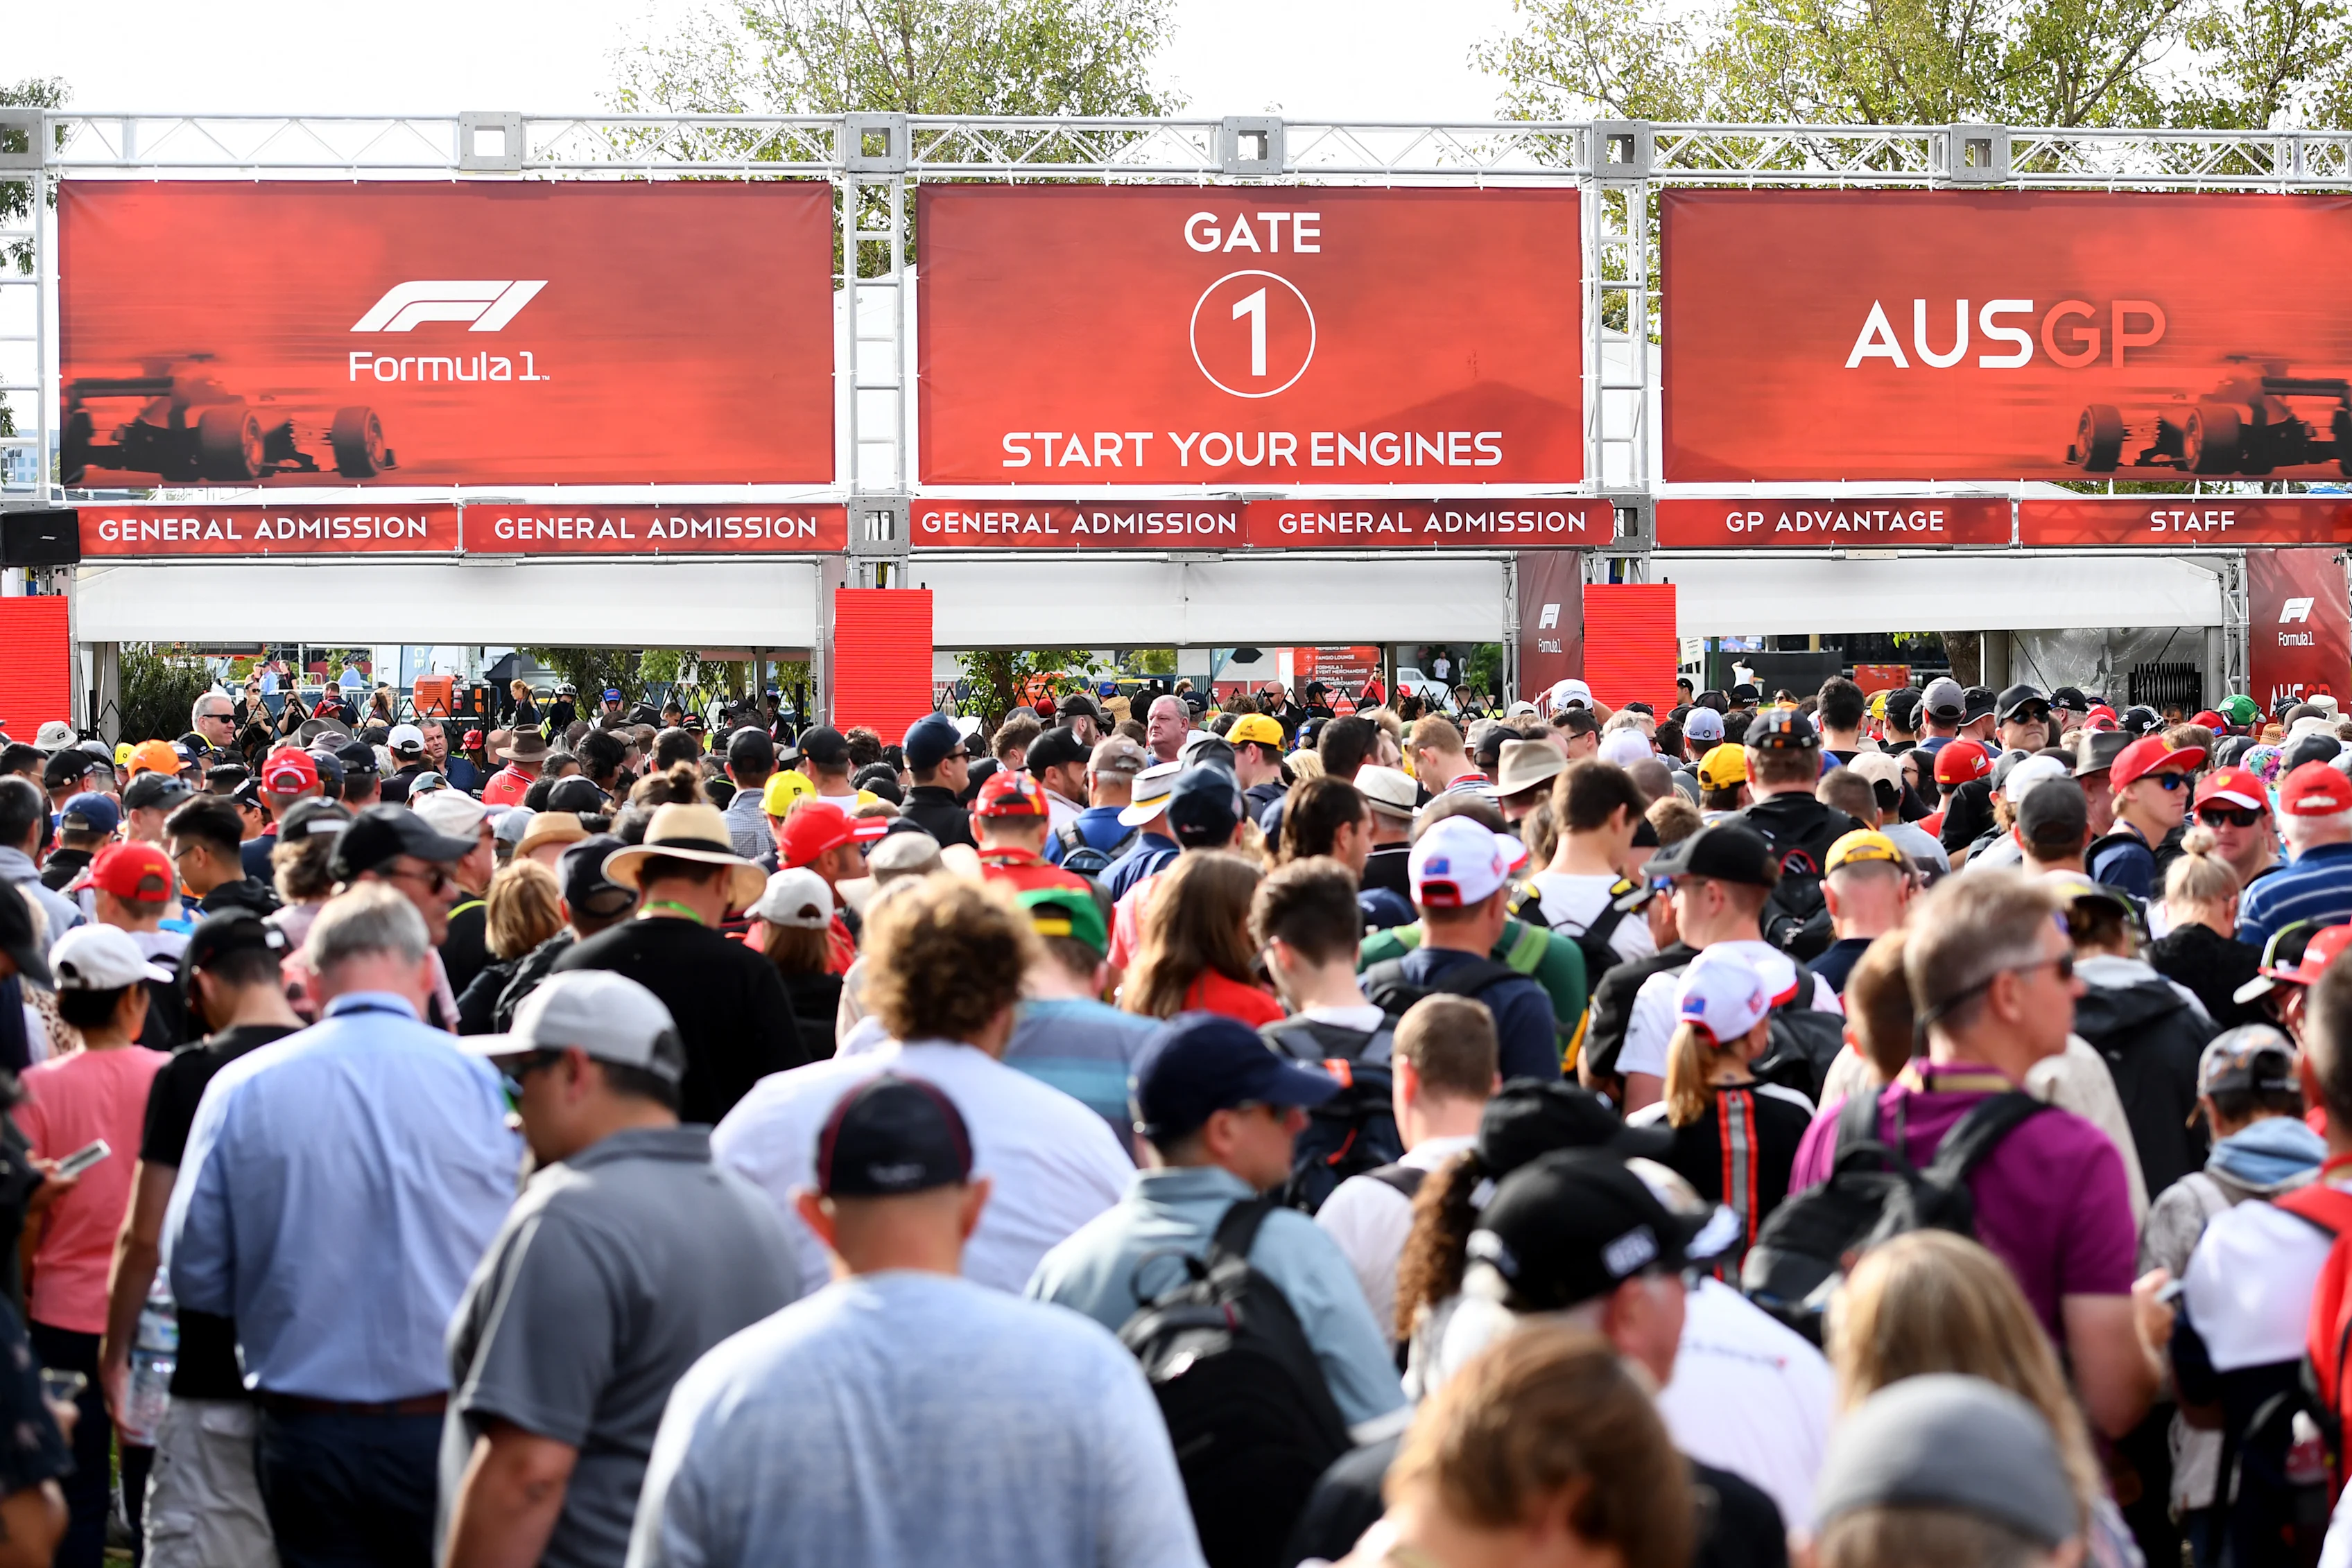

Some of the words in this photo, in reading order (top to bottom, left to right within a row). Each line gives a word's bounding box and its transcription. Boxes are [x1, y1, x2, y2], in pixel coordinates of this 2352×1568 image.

[1184, 211, 1320, 253] GATE
[1231, 286, 1268, 376] 1
[1844, 299, 2166, 368] AUSGP
[1003, 432, 1153, 467] START
[1168, 432, 1297, 467] YOUR
[1311, 430, 1503, 467] ENGINES
[98, 519, 242, 541] GENERAL
[254, 516, 427, 539] ADMISSION
[494, 517, 635, 539] GENERAL
[647, 516, 817, 539] ADMISSION
[922, 512, 1059, 534] GENERAL
[1071, 512, 1236, 534] ADMISSION
[1279, 512, 1412, 534] GENERAL
[1424, 511, 1586, 533] ADMISSION
[1726, 512, 1764, 532] GP
[1775, 509, 1944, 532] ADVANTAGE
[2150, 511, 2236, 532] STAFF
